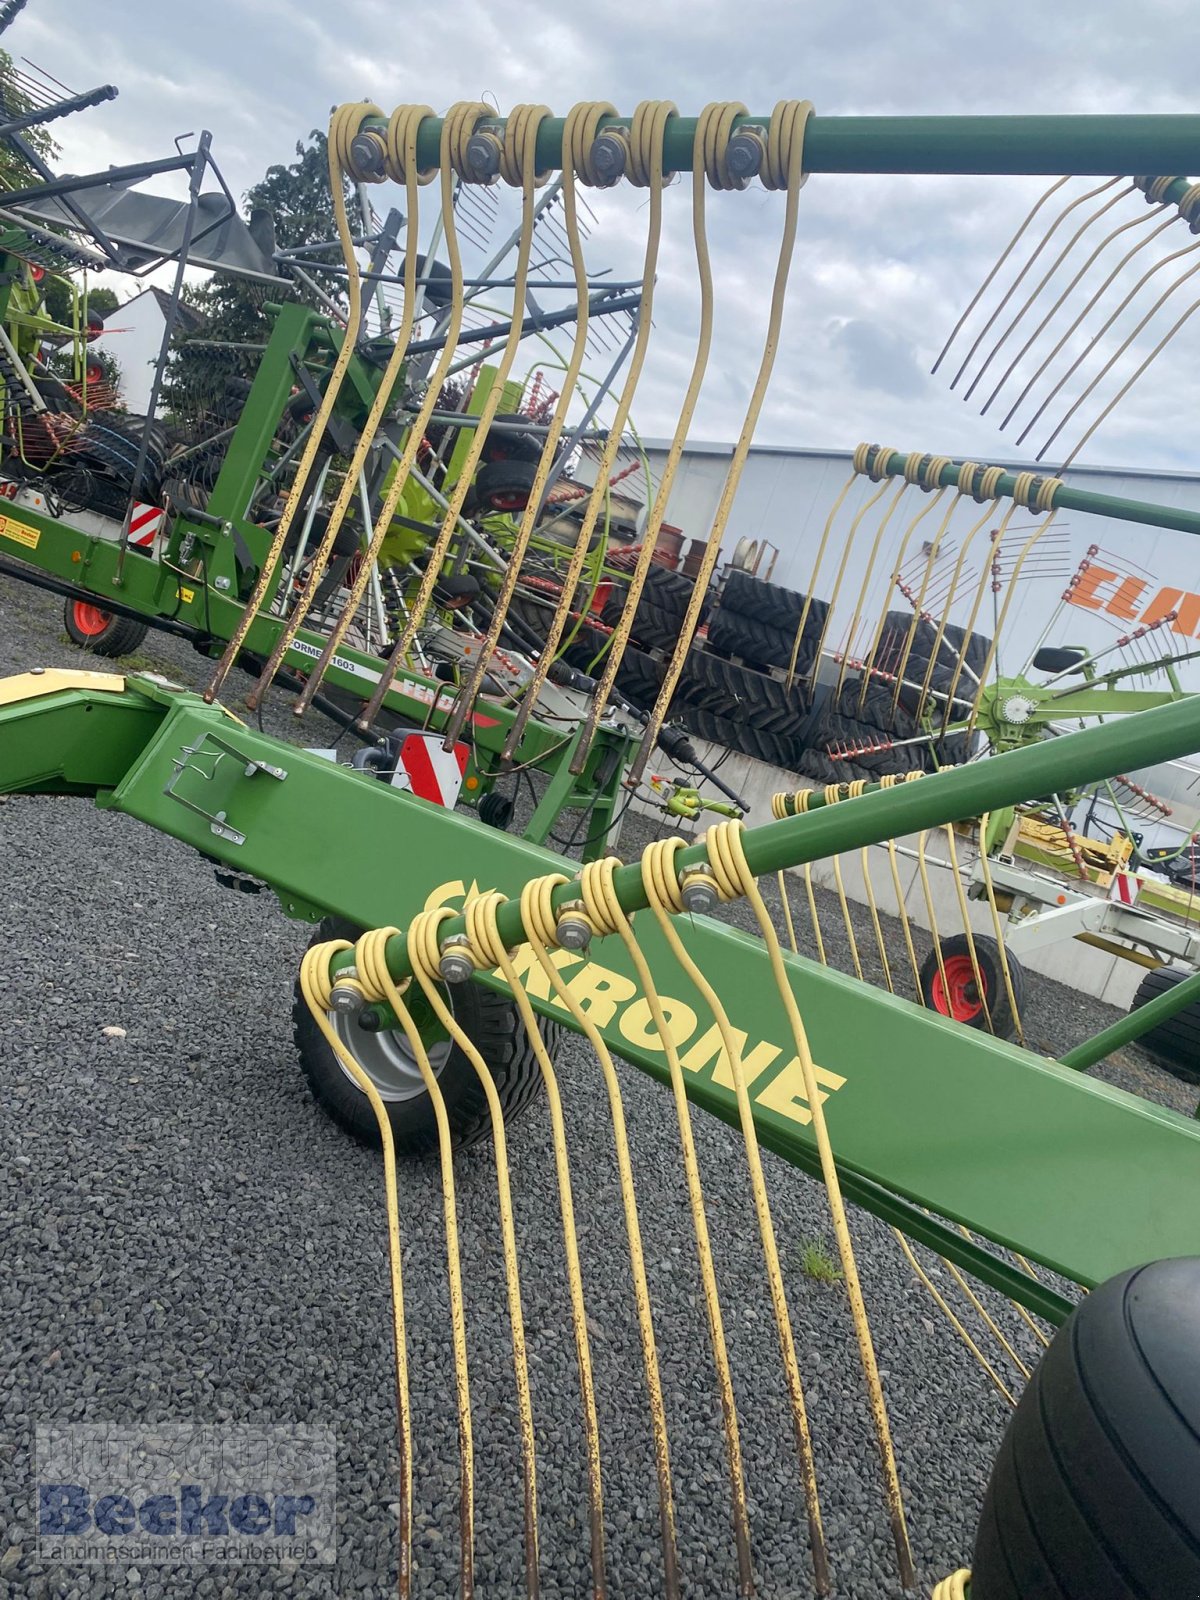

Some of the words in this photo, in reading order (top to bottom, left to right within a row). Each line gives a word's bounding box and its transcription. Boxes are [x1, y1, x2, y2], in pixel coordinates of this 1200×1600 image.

[1069, 566, 1200, 640] CLA
[290, 641, 323, 659] ORME
[332, 656, 355, 672] 1603
[404, 679, 462, 714] FEND
[492, 943, 848, 1126] KRONE
